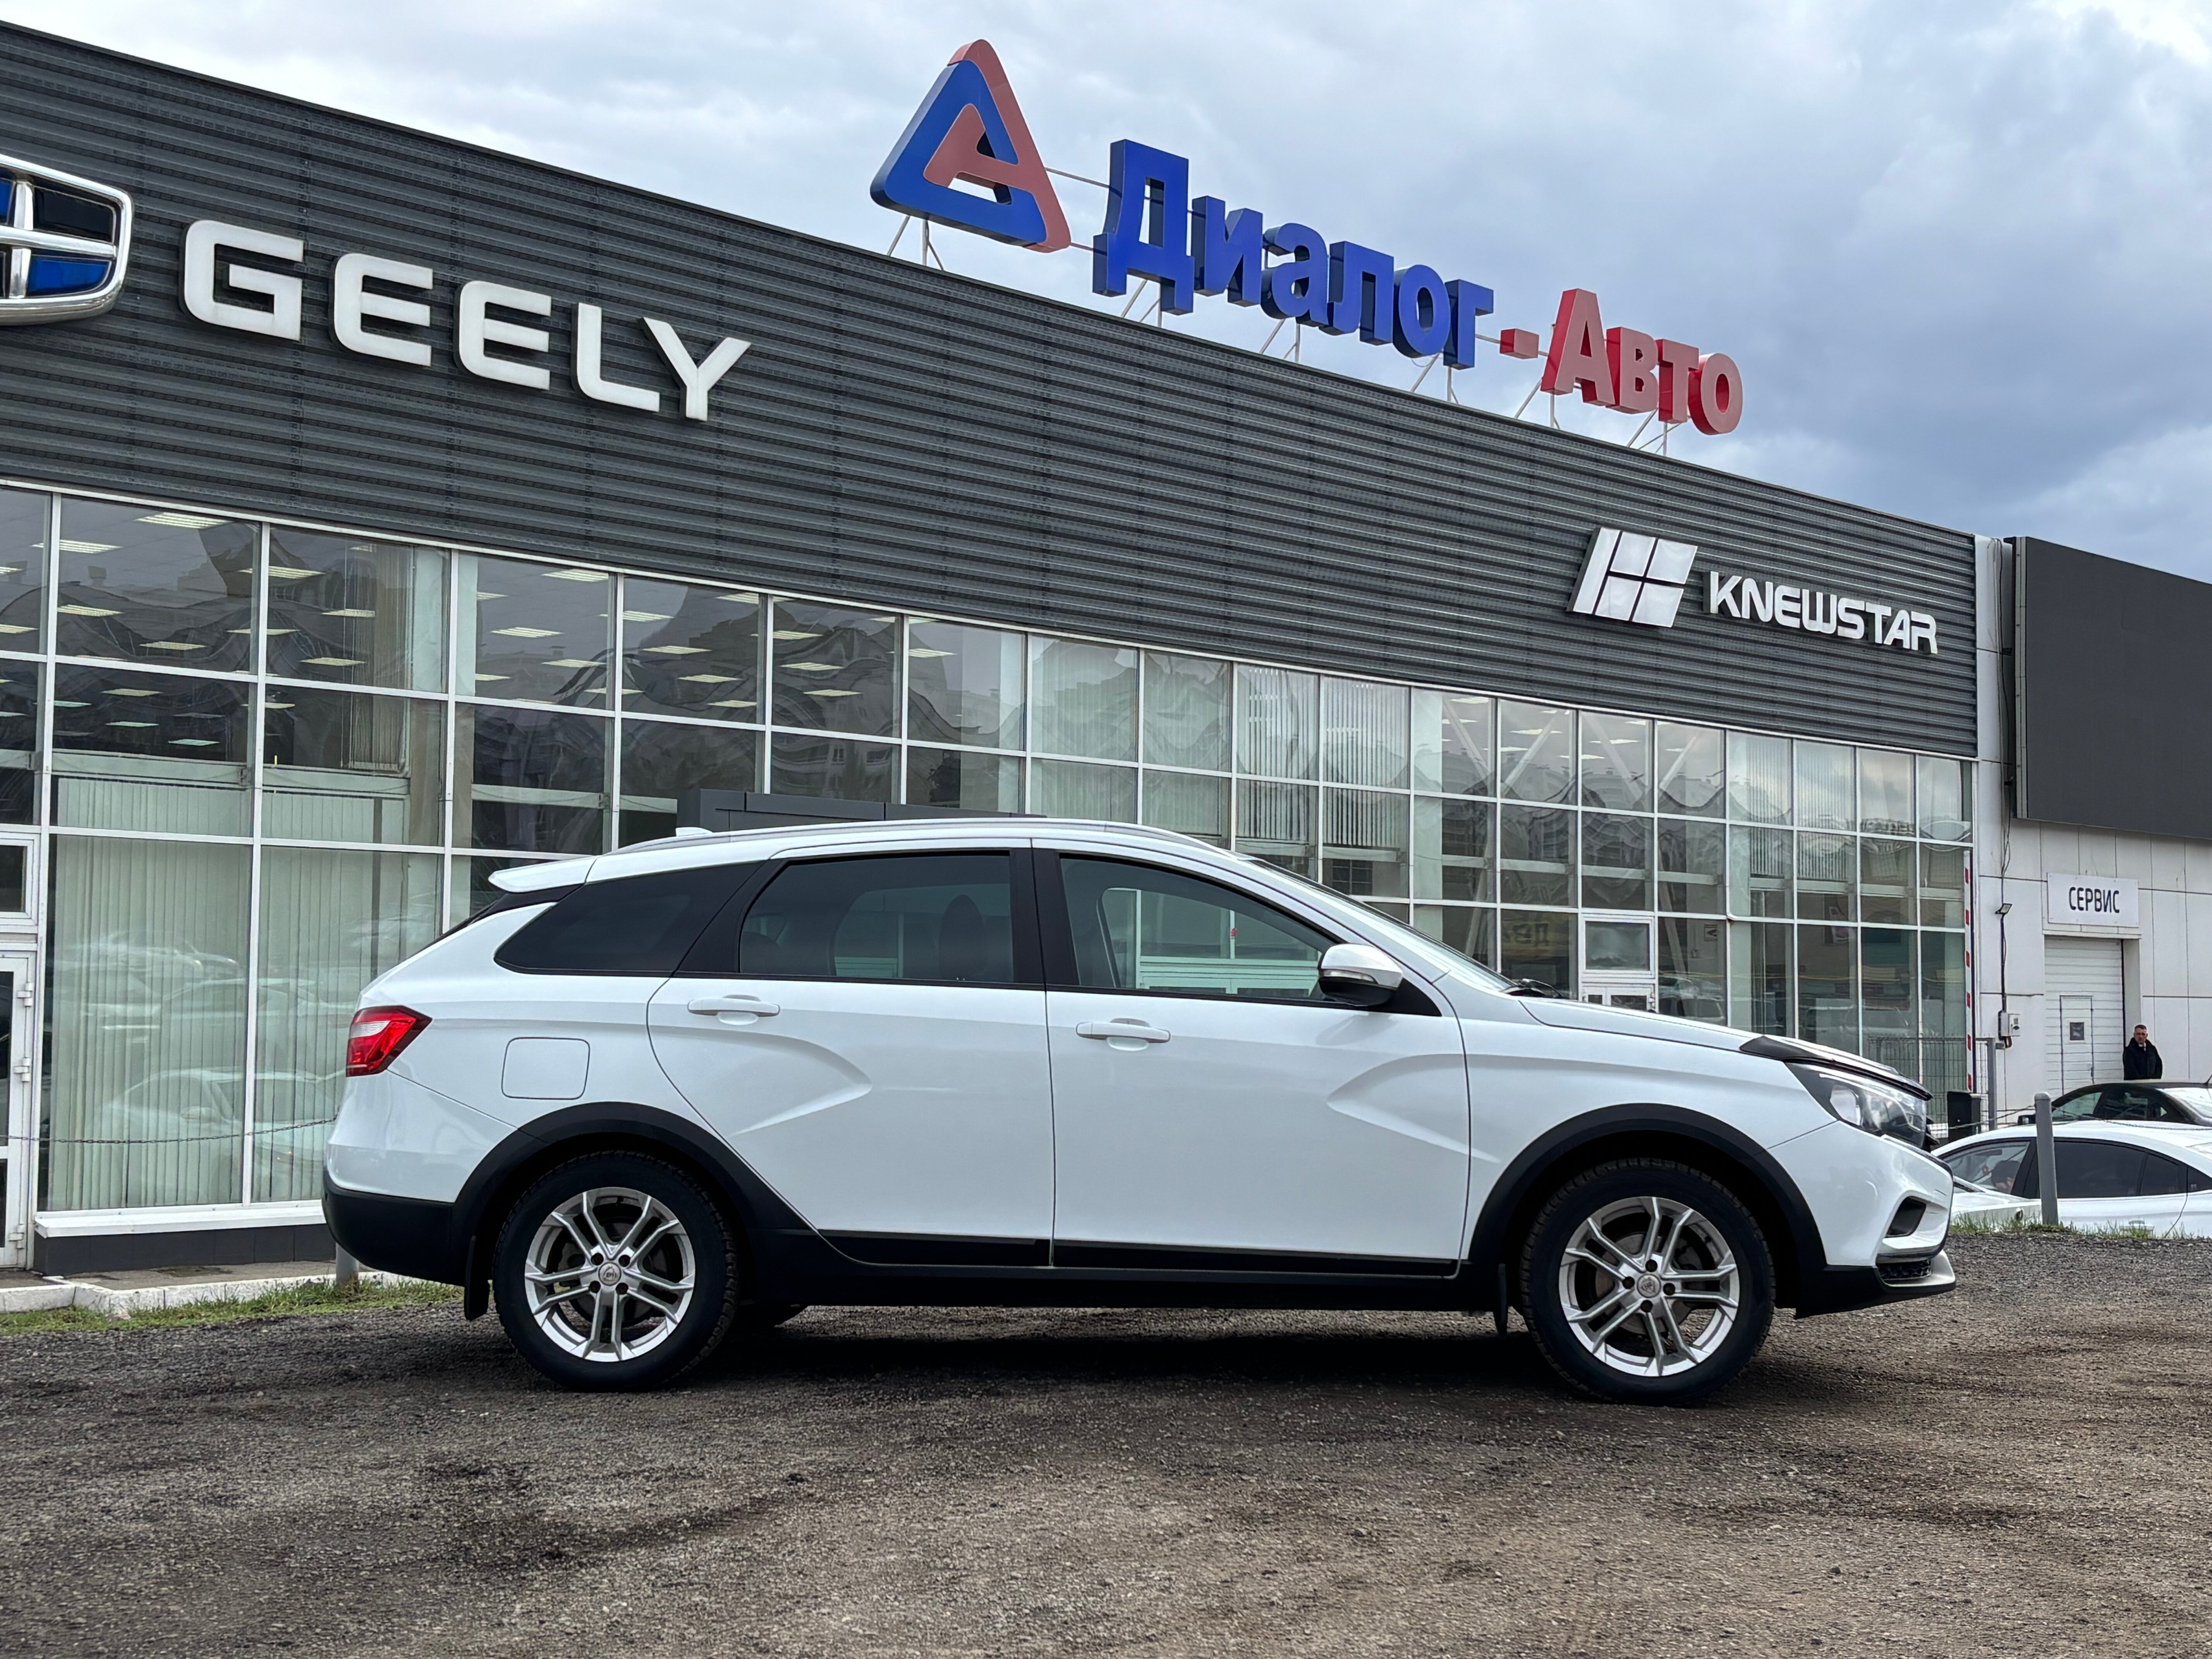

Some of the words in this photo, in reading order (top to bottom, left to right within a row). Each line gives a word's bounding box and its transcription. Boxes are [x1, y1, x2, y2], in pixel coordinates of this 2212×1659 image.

[184, 220, 751, 422] GEELY
[1705, 571, 1938, 654] KNEWSTAR
[2069, 886, 2120, 914] СЕРВИС
